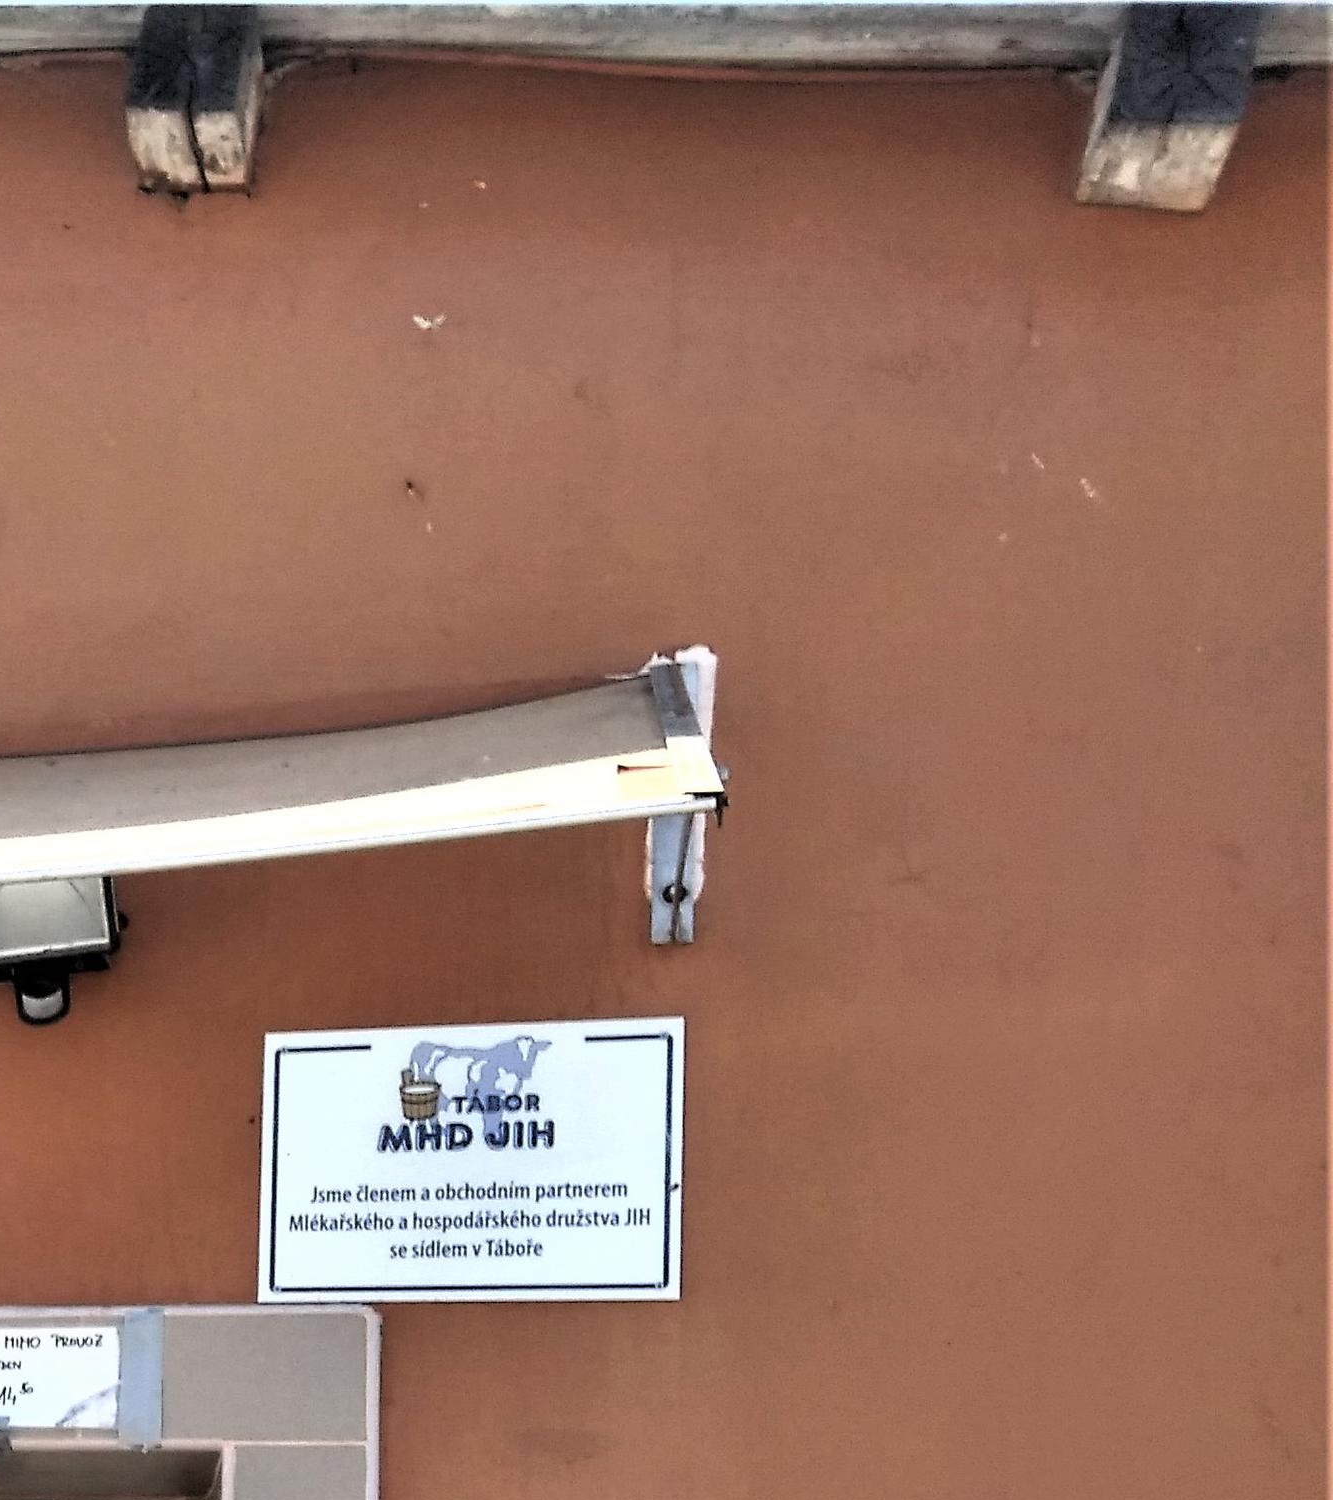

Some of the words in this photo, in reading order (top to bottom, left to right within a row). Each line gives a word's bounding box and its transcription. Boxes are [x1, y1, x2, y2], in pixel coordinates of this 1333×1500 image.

[452, 1089, 540, 1114] TÁBOR
[377, 1123, 473, 1153] MHD
[485, 1120, 555, 1151] JIH
[311, 1186, 352, 1204] Jsme
[356, 1185, 416, 1203] členem
[420, 1188, 430, 1201] a
[435, 1182, 530, 1201] obchodním
[535, 1182, 628, 1203] partnerem
[289, 1212, 394, 1232] Mlékařského
[398, 1217, 408, 1230] a
[413, 1210, 541, 1233] hospodářského
[545, 1209, 620, 1228] družstva
[624, 1207, 651, 1227] JIH
[389, 1245, 407, 1259] se
[412, 1240, 468, 1259] sídlem
[472, 1243, 482, 1257] v
[486, 1238, 543, 1257] Táboře
[5, 1336, 41, 1349] MIMO
[51, 1333, 103, 1348] PROVOZ
[0, 1360, 22, 1370] DEN
